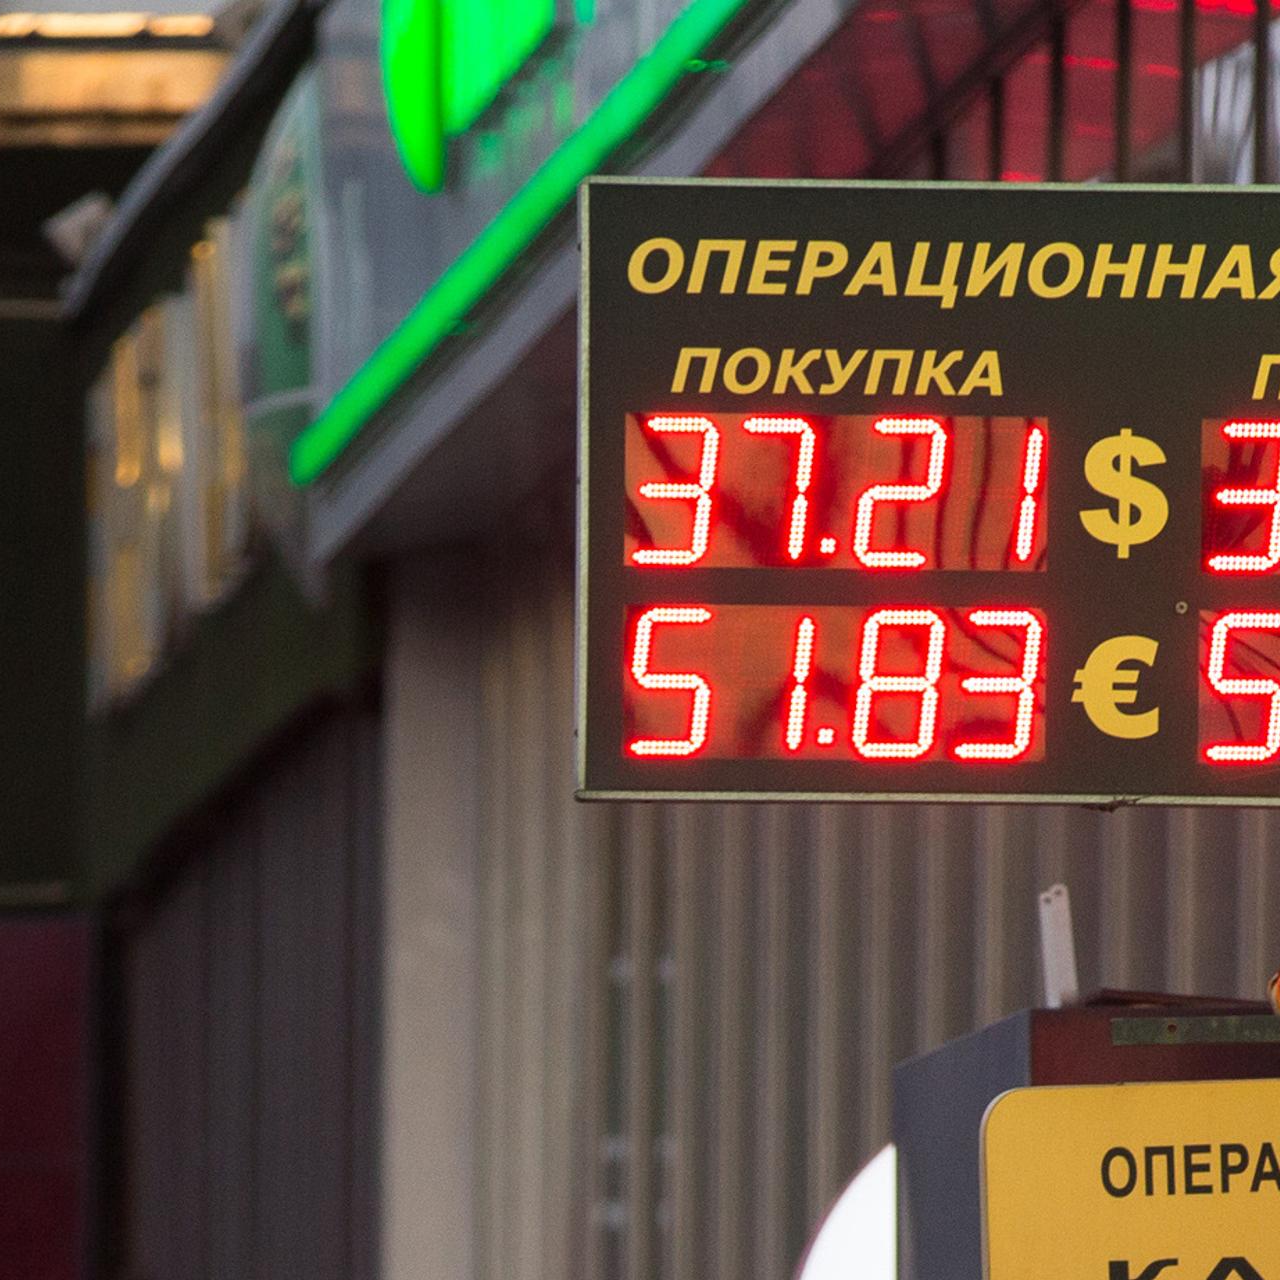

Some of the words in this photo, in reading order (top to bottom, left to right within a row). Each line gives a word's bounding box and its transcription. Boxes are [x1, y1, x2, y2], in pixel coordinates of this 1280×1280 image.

[670, 346, 1004, 396] ПОКУПКА
[631, 415, 1045, 568] 37.21
[1079, 428, 1170, 559] $
[629, 606, 1044, 760] 51.83
[1071, 635, 1160, 739] €
